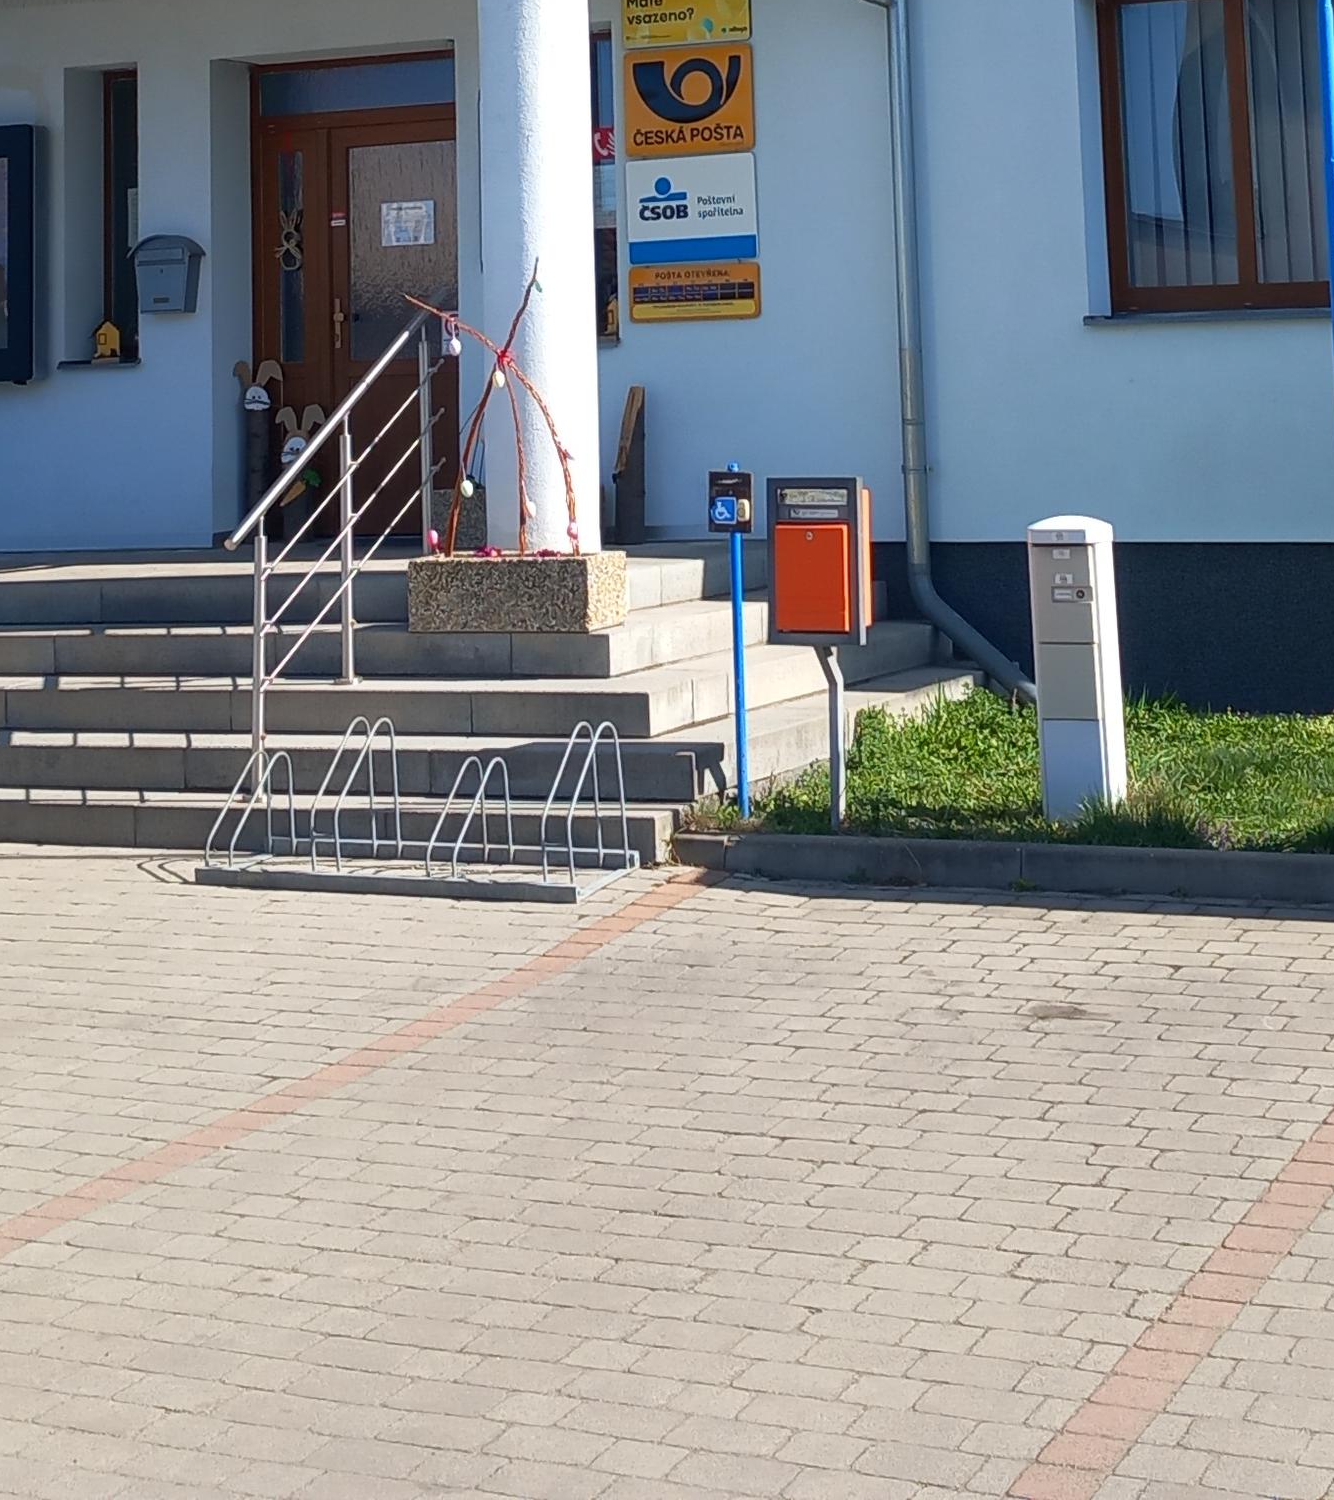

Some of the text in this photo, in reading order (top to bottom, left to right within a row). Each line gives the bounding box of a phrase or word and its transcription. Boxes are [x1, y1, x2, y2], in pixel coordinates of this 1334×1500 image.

[627, 7, 694, 25] vsazeno?
[633, 122, 744, 146] ČESKÁ POŠTA
[697, 194, 736, 206] Poštovní
[639, 204, 689, 221] ČSOB
[697, 206, 744, 220] spořitelna
[654, 270, 682, 280] POŠTA
